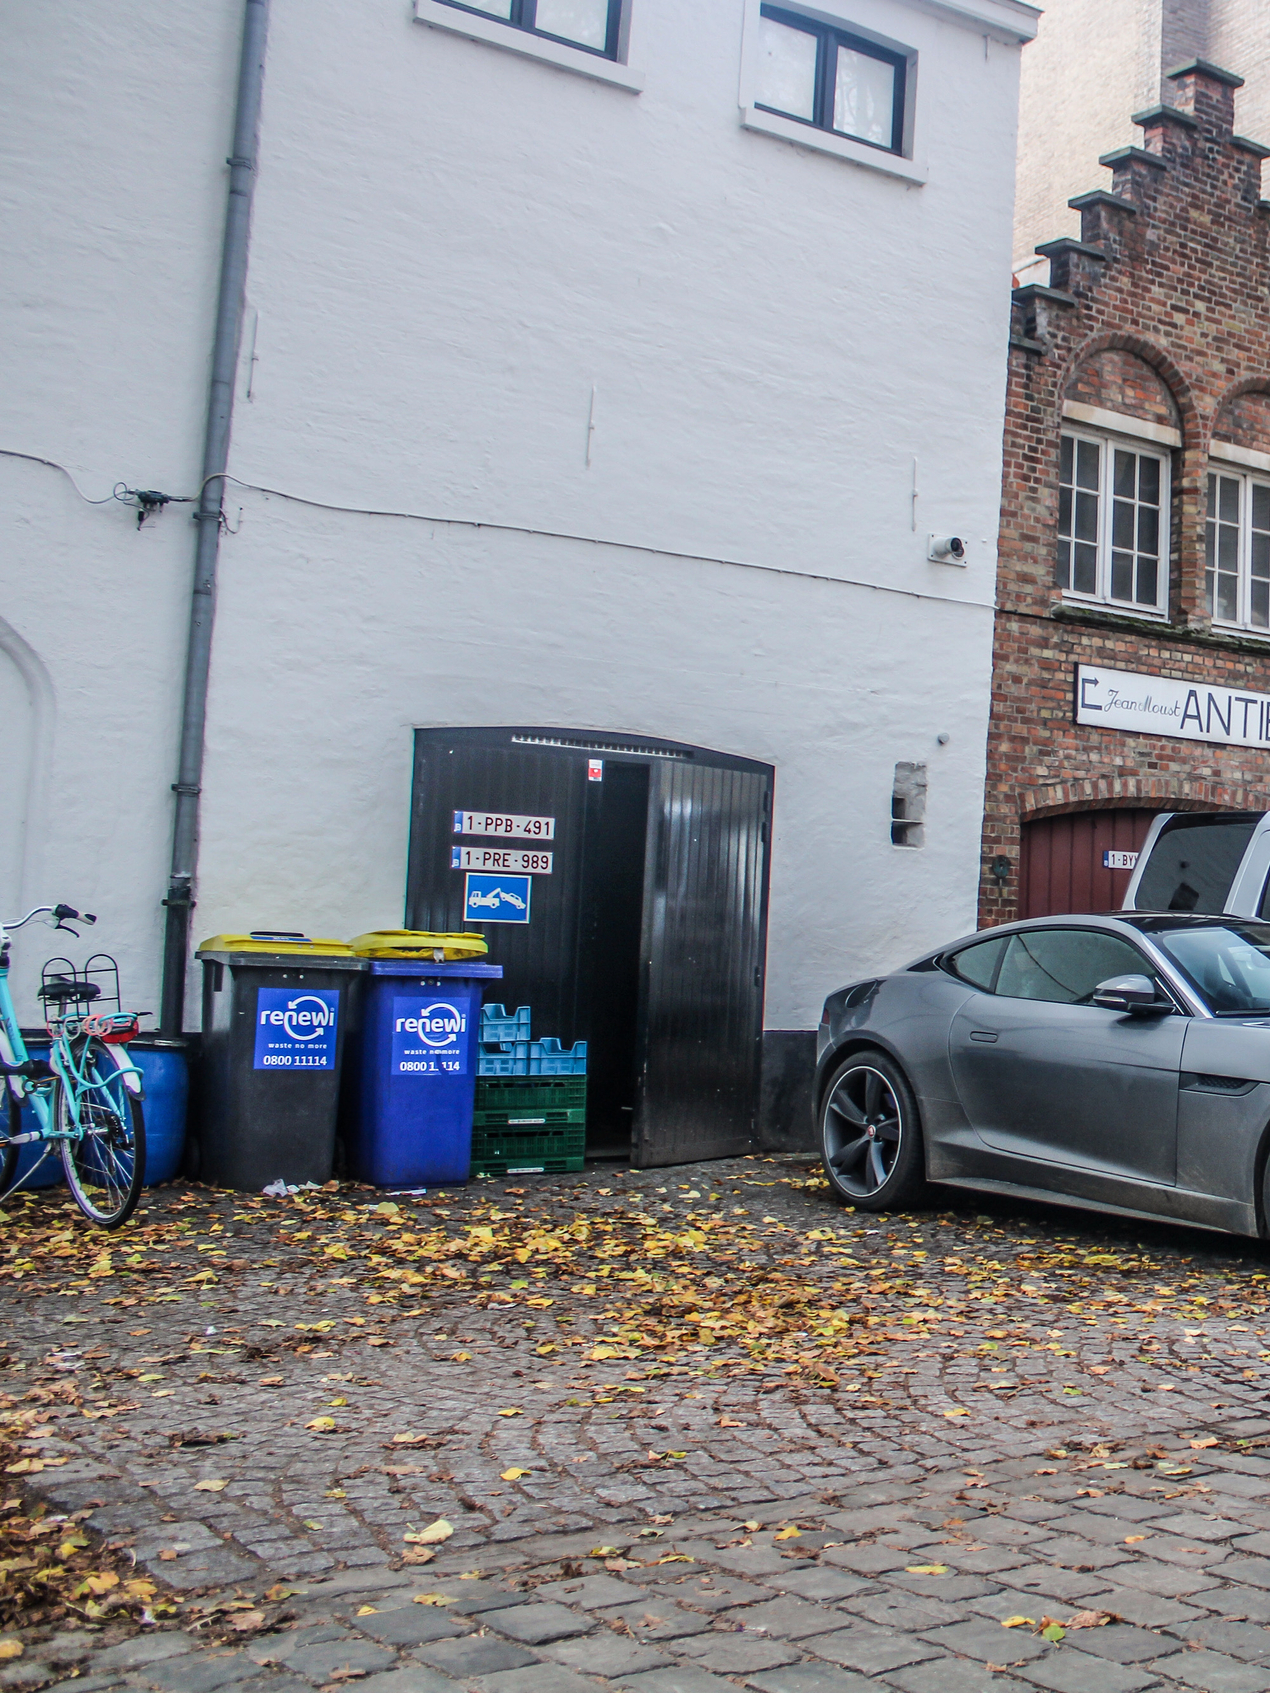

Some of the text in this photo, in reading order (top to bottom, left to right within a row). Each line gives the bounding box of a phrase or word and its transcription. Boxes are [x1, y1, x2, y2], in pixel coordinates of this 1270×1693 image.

[467, 815, 550, 836] 1-PPB-491
[465, 851, 549, 870] 1-PRE-989
[260, 1005, 335, 1028] renewi
[395, 1012, 467, 1034] renewi
[263, 1055, 327, 1066] 0800 11114
[400, 1061, 460, 1071] 0800 1114
